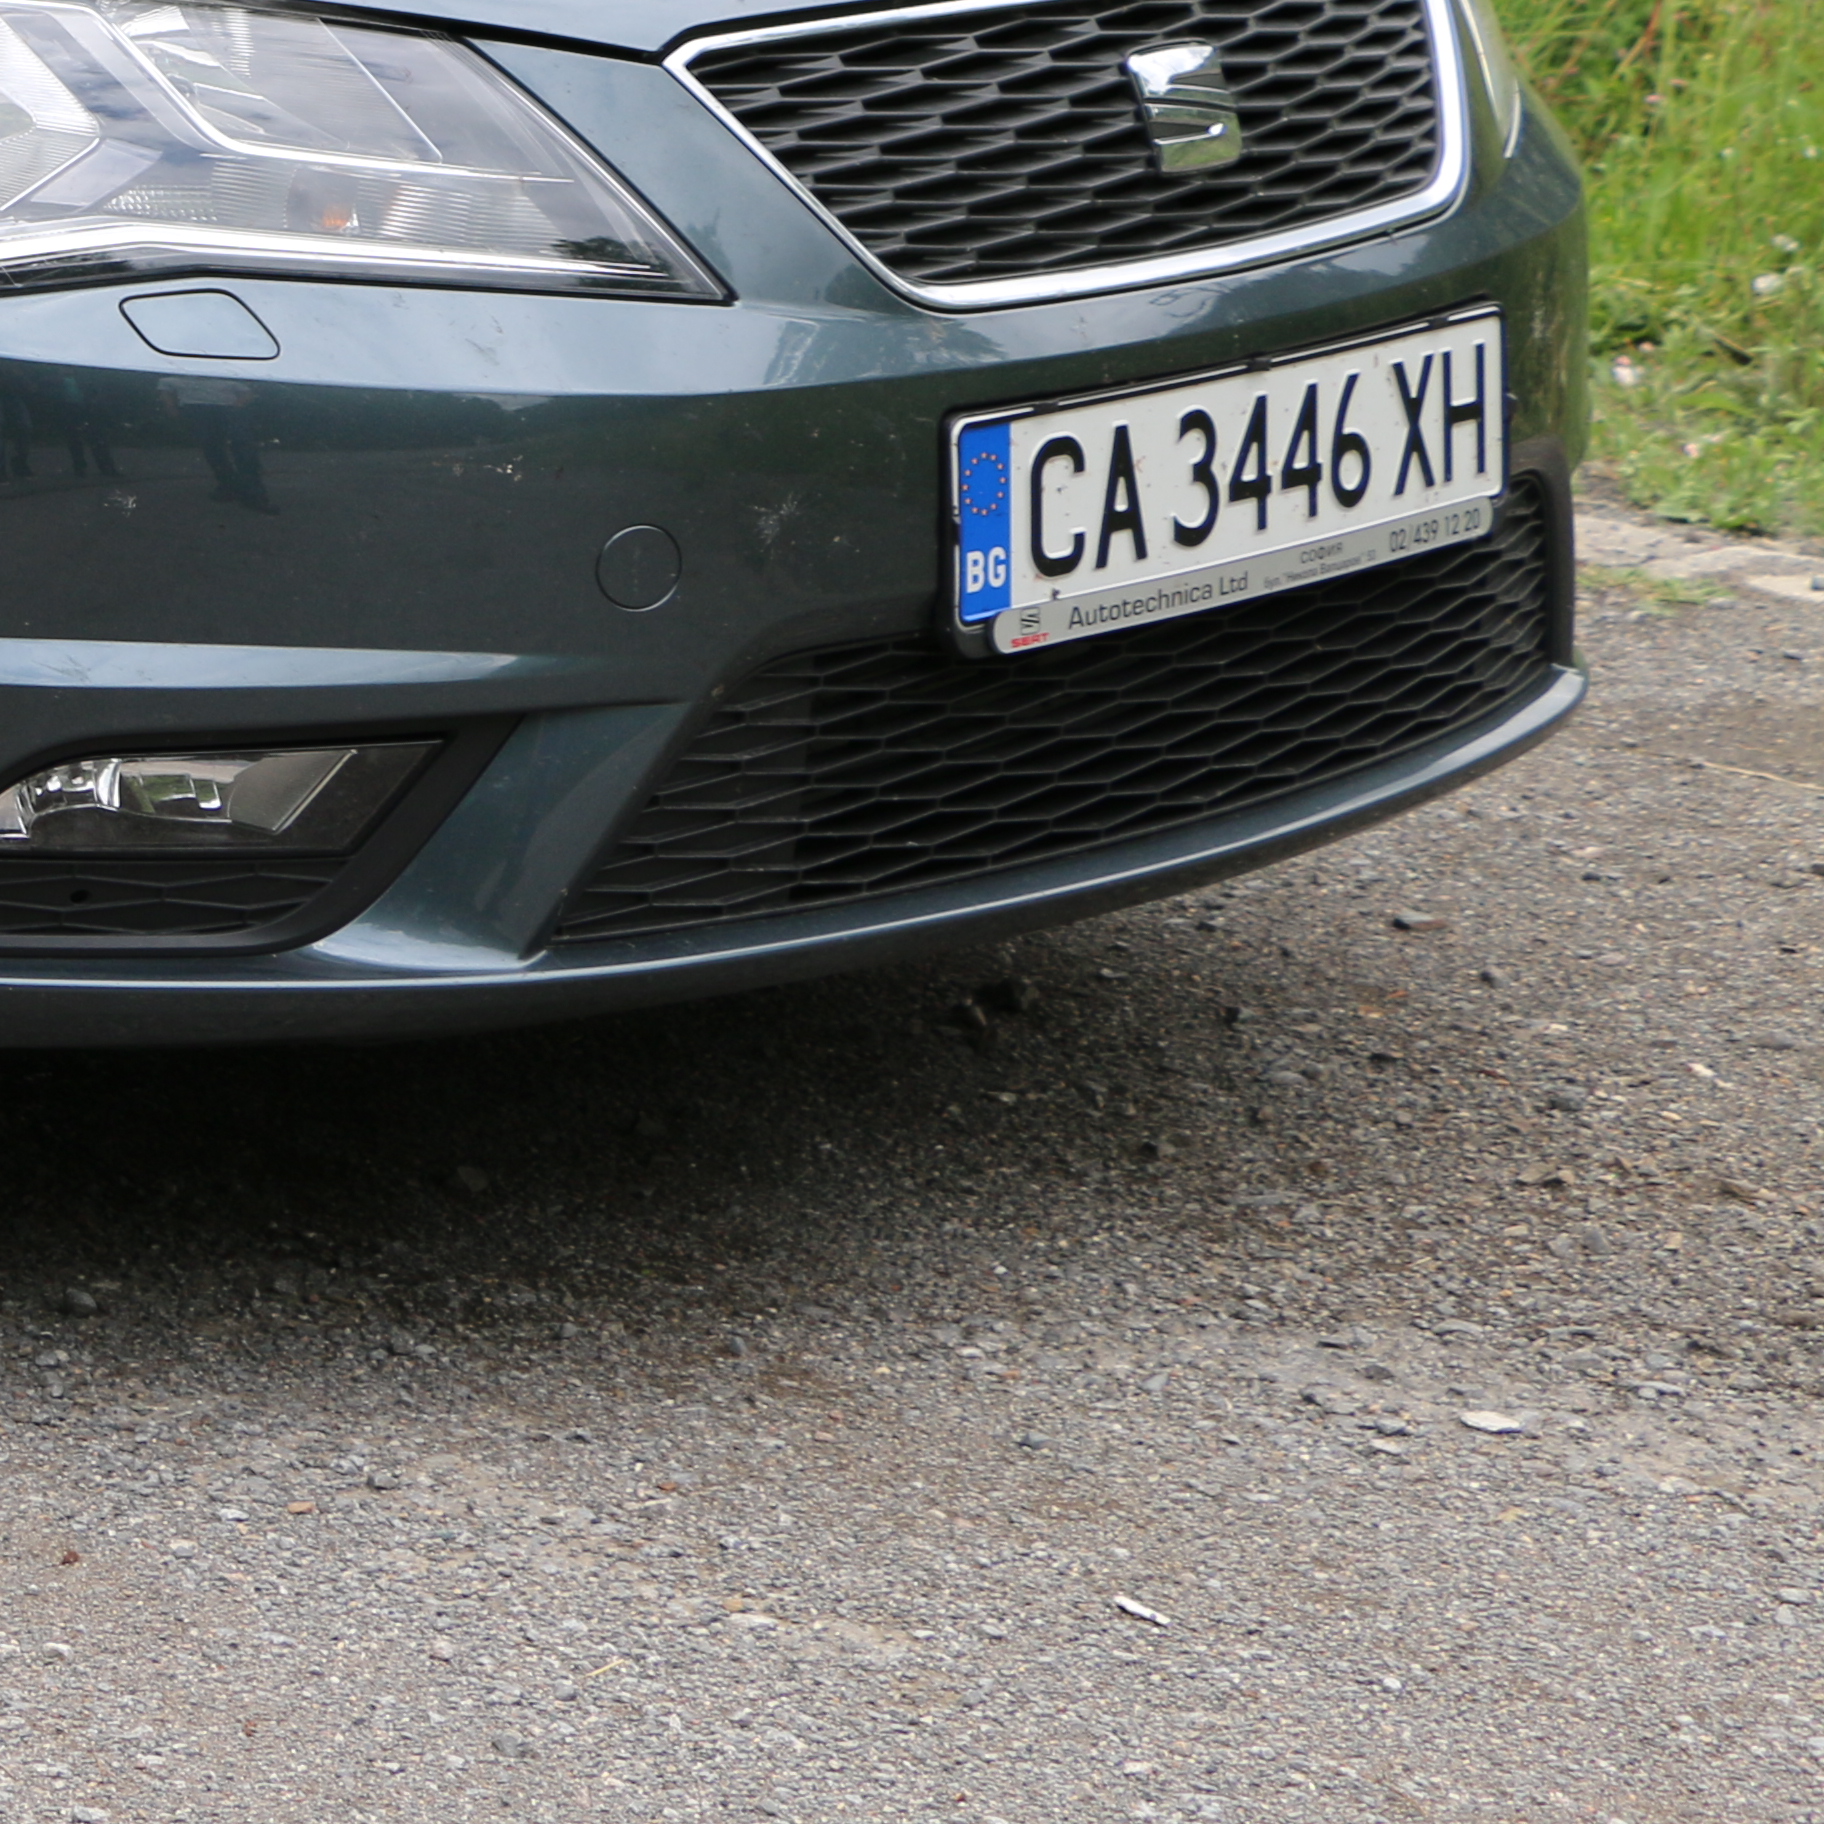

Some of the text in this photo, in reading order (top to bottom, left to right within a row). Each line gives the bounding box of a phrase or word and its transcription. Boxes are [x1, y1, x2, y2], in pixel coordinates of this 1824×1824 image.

[1029, 341, 1485, 578] CA 3446 XH
[1389, 508, 1481, 553] 02/439 12 20
[966, 549, 1007, 594] BG
[1068, 582, 1213, 630] Autotechnica
[1219, 570, 1249, 596] Ltd
[1010, 632, 1050, 648] SEAT
